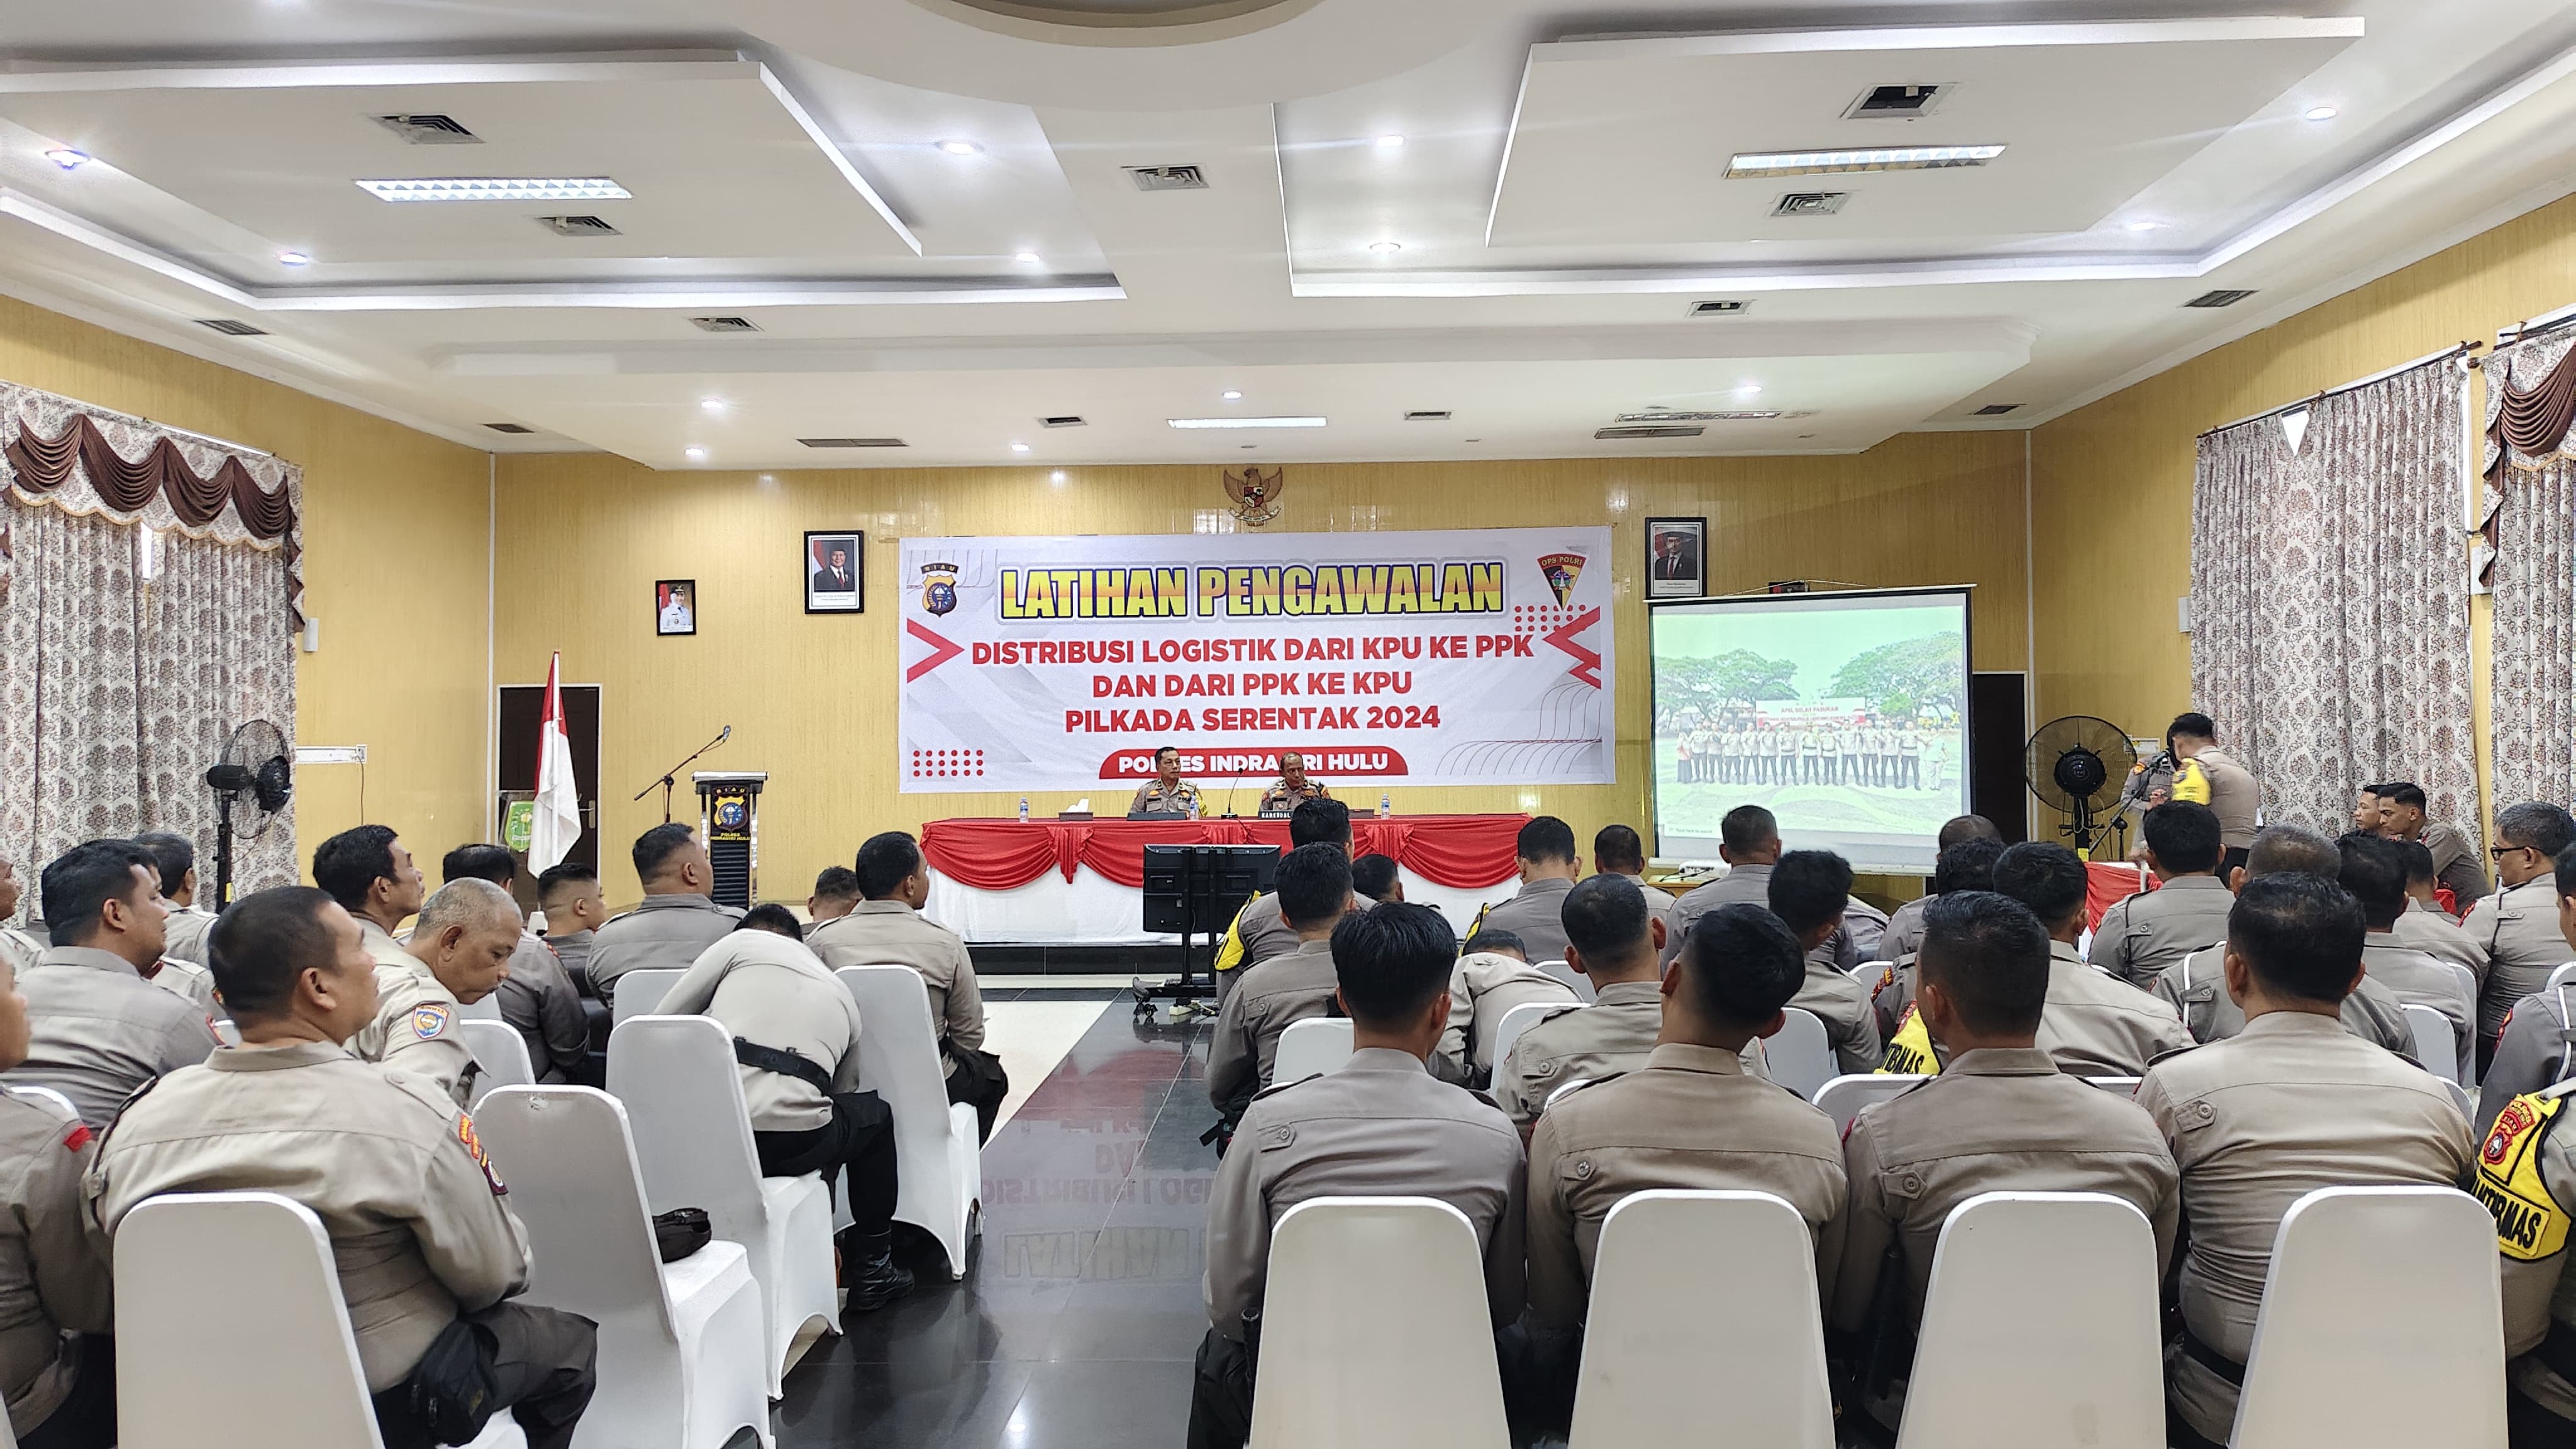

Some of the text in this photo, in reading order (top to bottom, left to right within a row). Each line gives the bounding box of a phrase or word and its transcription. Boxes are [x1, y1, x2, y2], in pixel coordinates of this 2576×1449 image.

[1541, 556, 1583, 566] OPS POLRI
[1001, 562, 1503, 619] LATIHAN PENGAWALAN
[973, 635, 1535, 665] DISTRIBUSI LOGISTIK DARI KPU KE PPK
[1093, 671, 1412, 698] DAN DARI PPK KE KPU
[1066, 705, 1440, 733] PILKADA SERENTAK 2024
[1119, 753, 1388, 773] POLES INDRARI HULU
